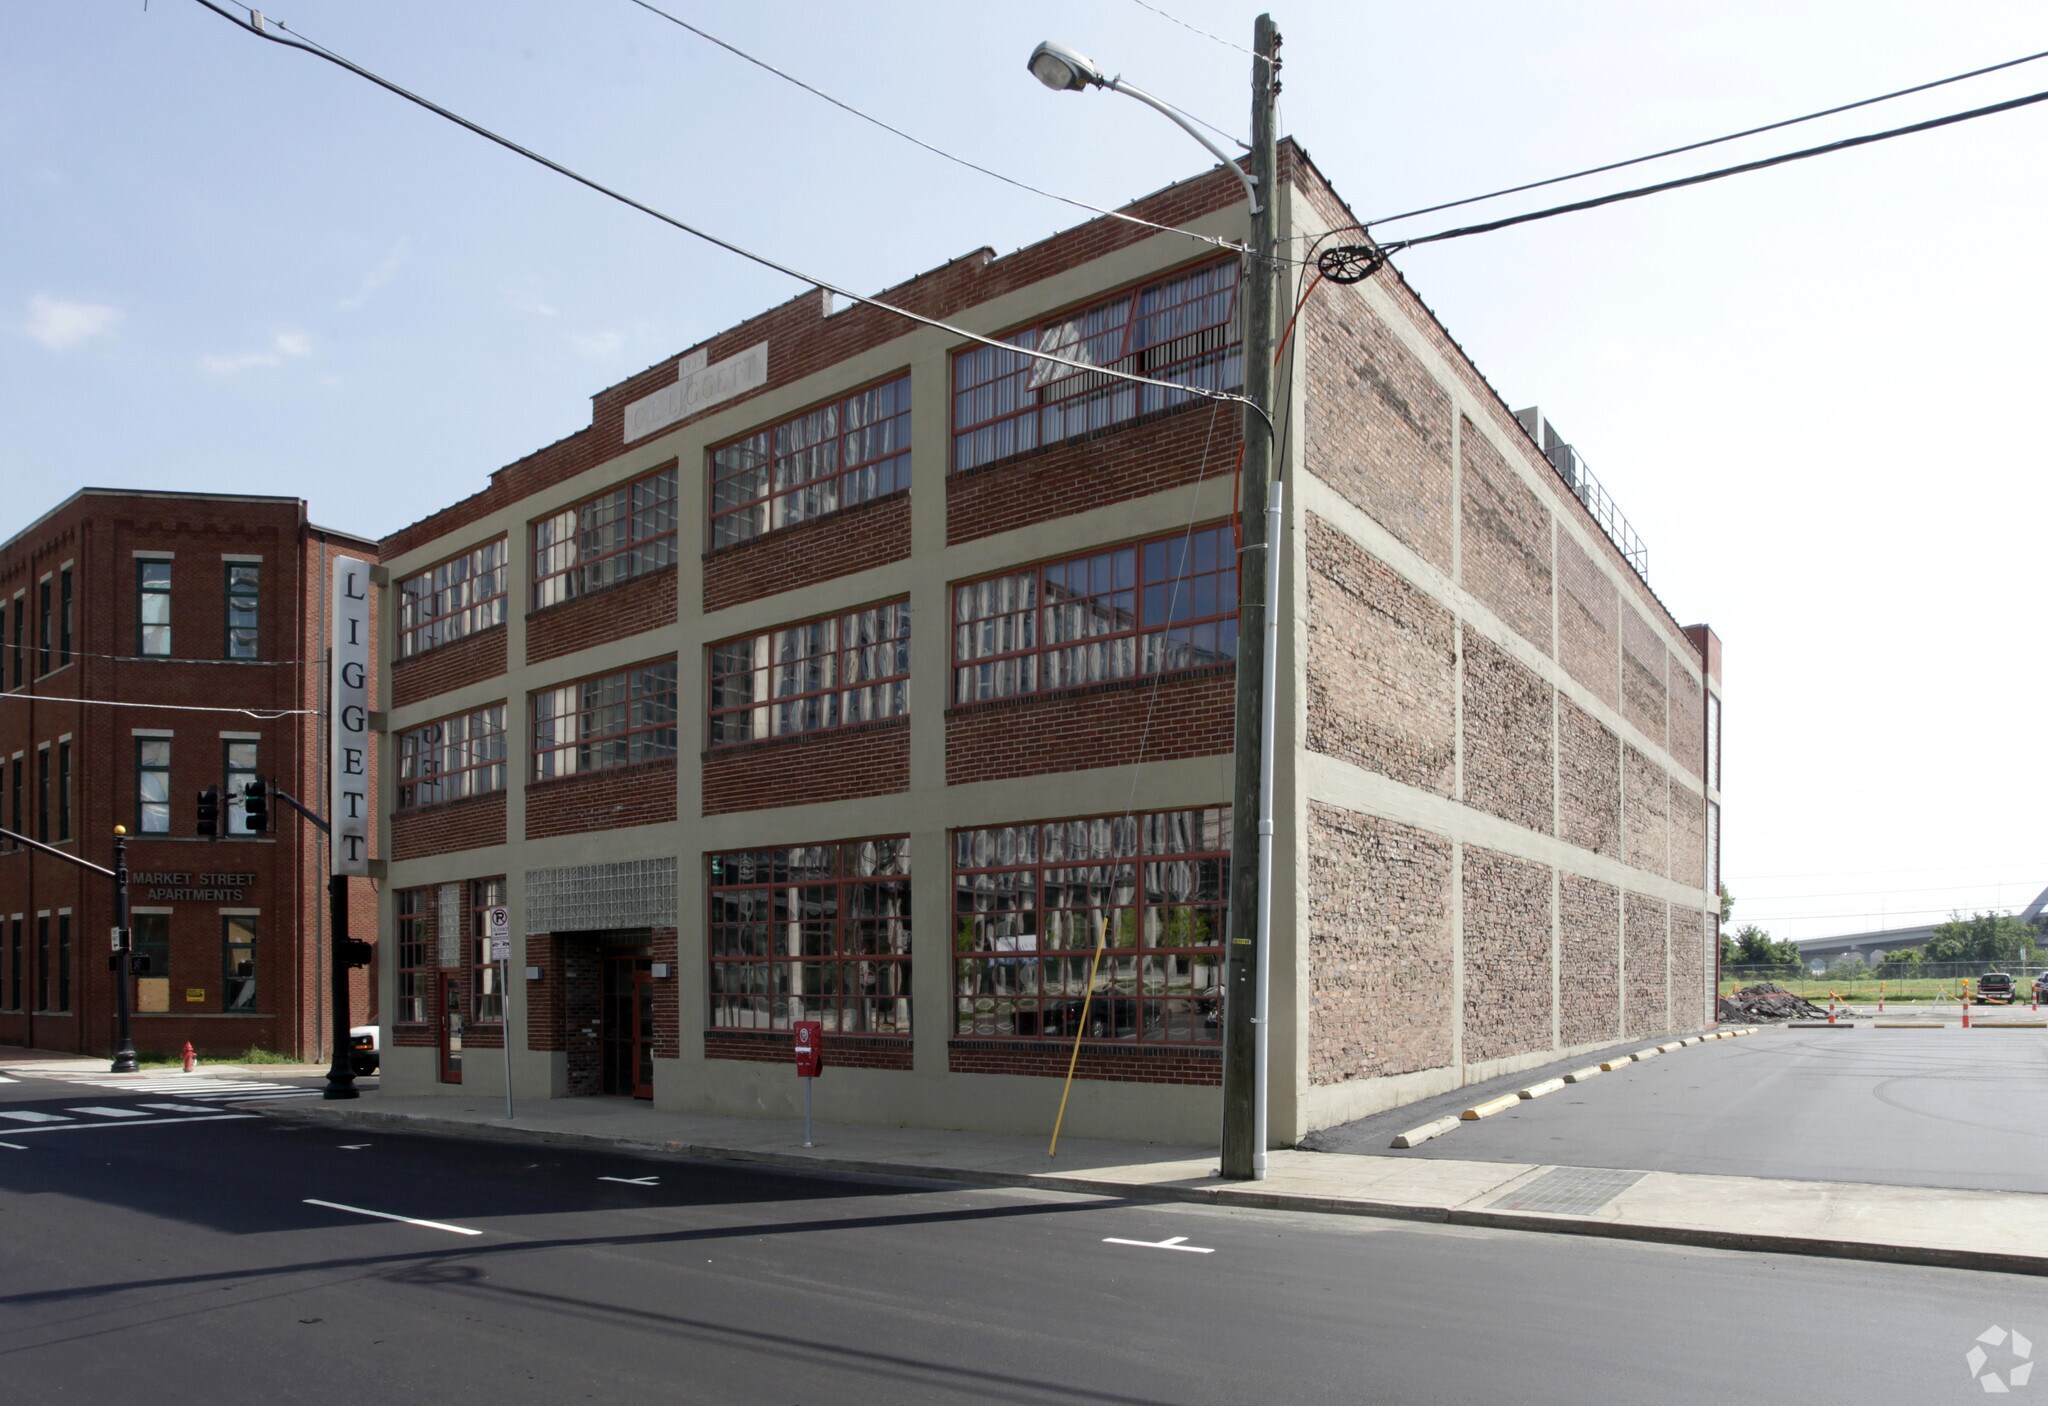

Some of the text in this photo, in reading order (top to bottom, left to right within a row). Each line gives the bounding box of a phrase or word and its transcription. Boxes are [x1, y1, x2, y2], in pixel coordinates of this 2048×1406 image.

[668, 353, 756, 415] LIGGETT
[341, 572, 366, 861] LIGGETT
[132, 872, 256, 885] MARKET STREET
[147, 888, 244, 901] APARTMENTS
